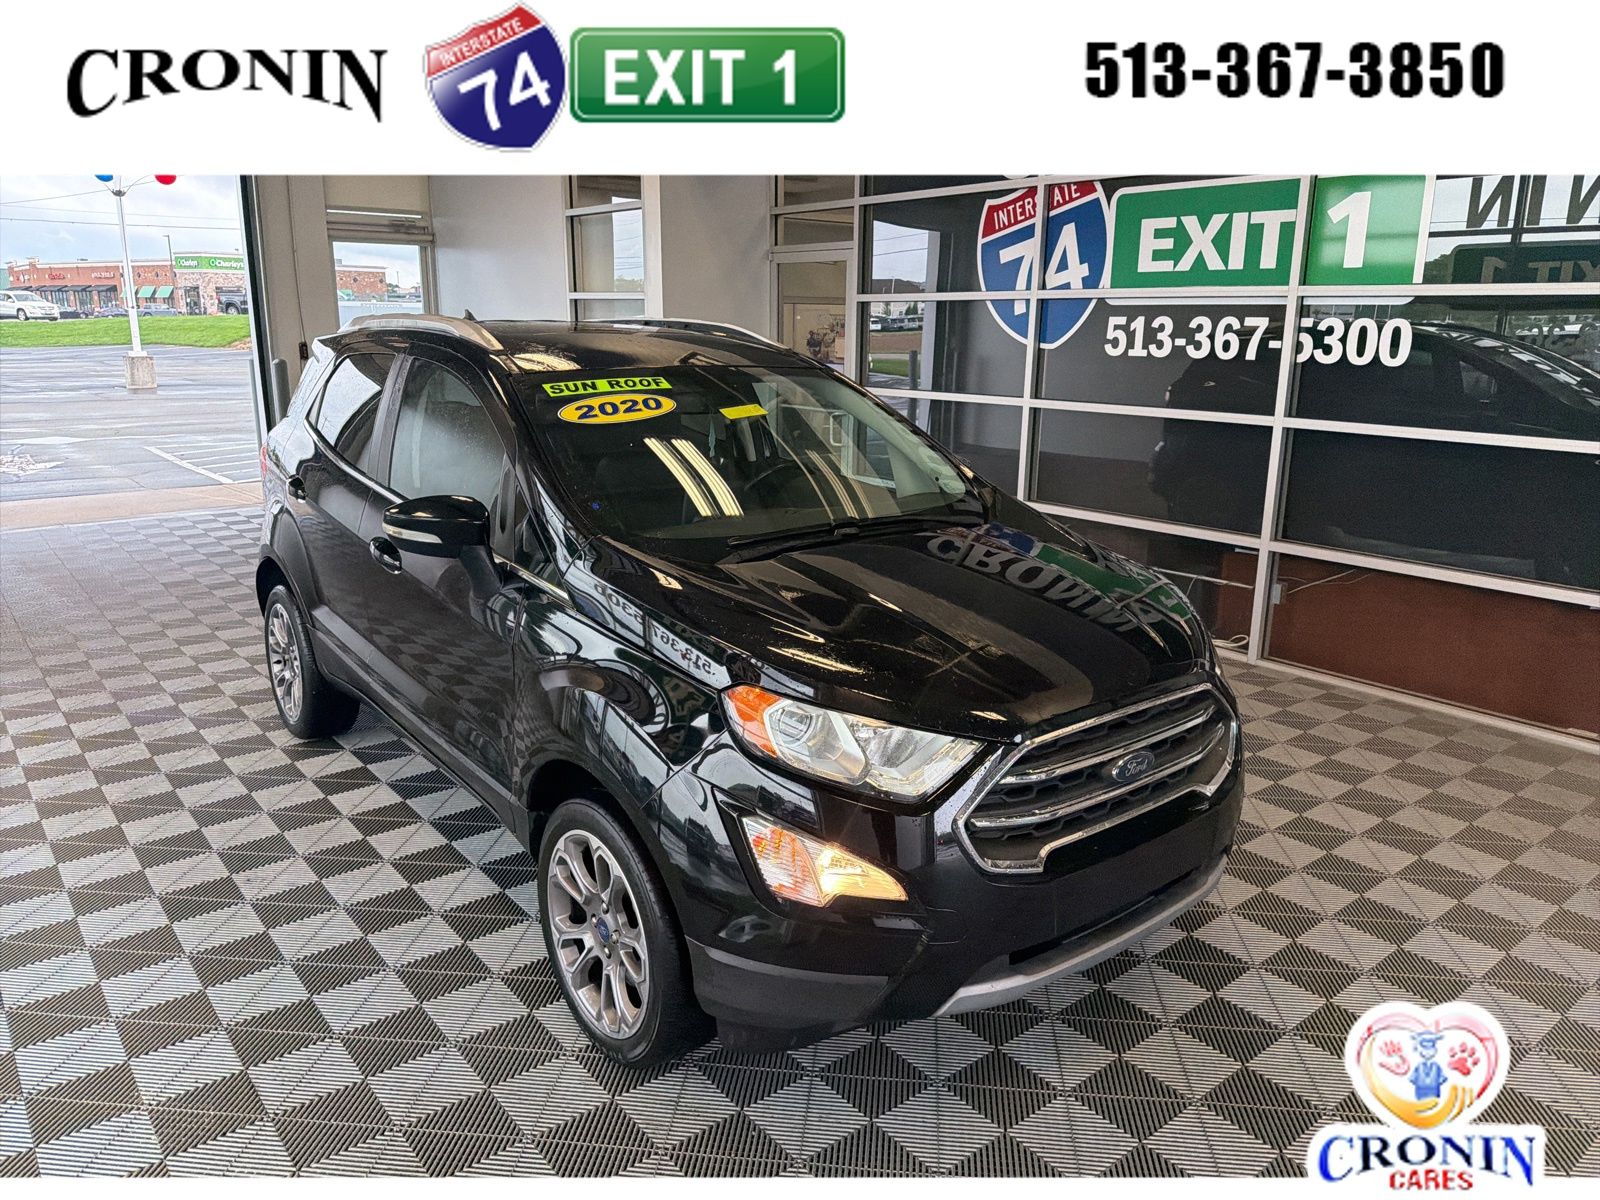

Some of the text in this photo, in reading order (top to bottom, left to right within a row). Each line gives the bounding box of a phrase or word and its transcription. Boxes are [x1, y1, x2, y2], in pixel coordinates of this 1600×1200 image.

[993, 183, 1081, 230] INTERATE
[1137, 190, 1373, 275] EXIT 1
[998, 221, 1090, 316] 74
[549, 377, 664, 395] SUN ROOF
[574, 396, 663, 420] 2020
[1125, 757, 1148, 777] Ford
